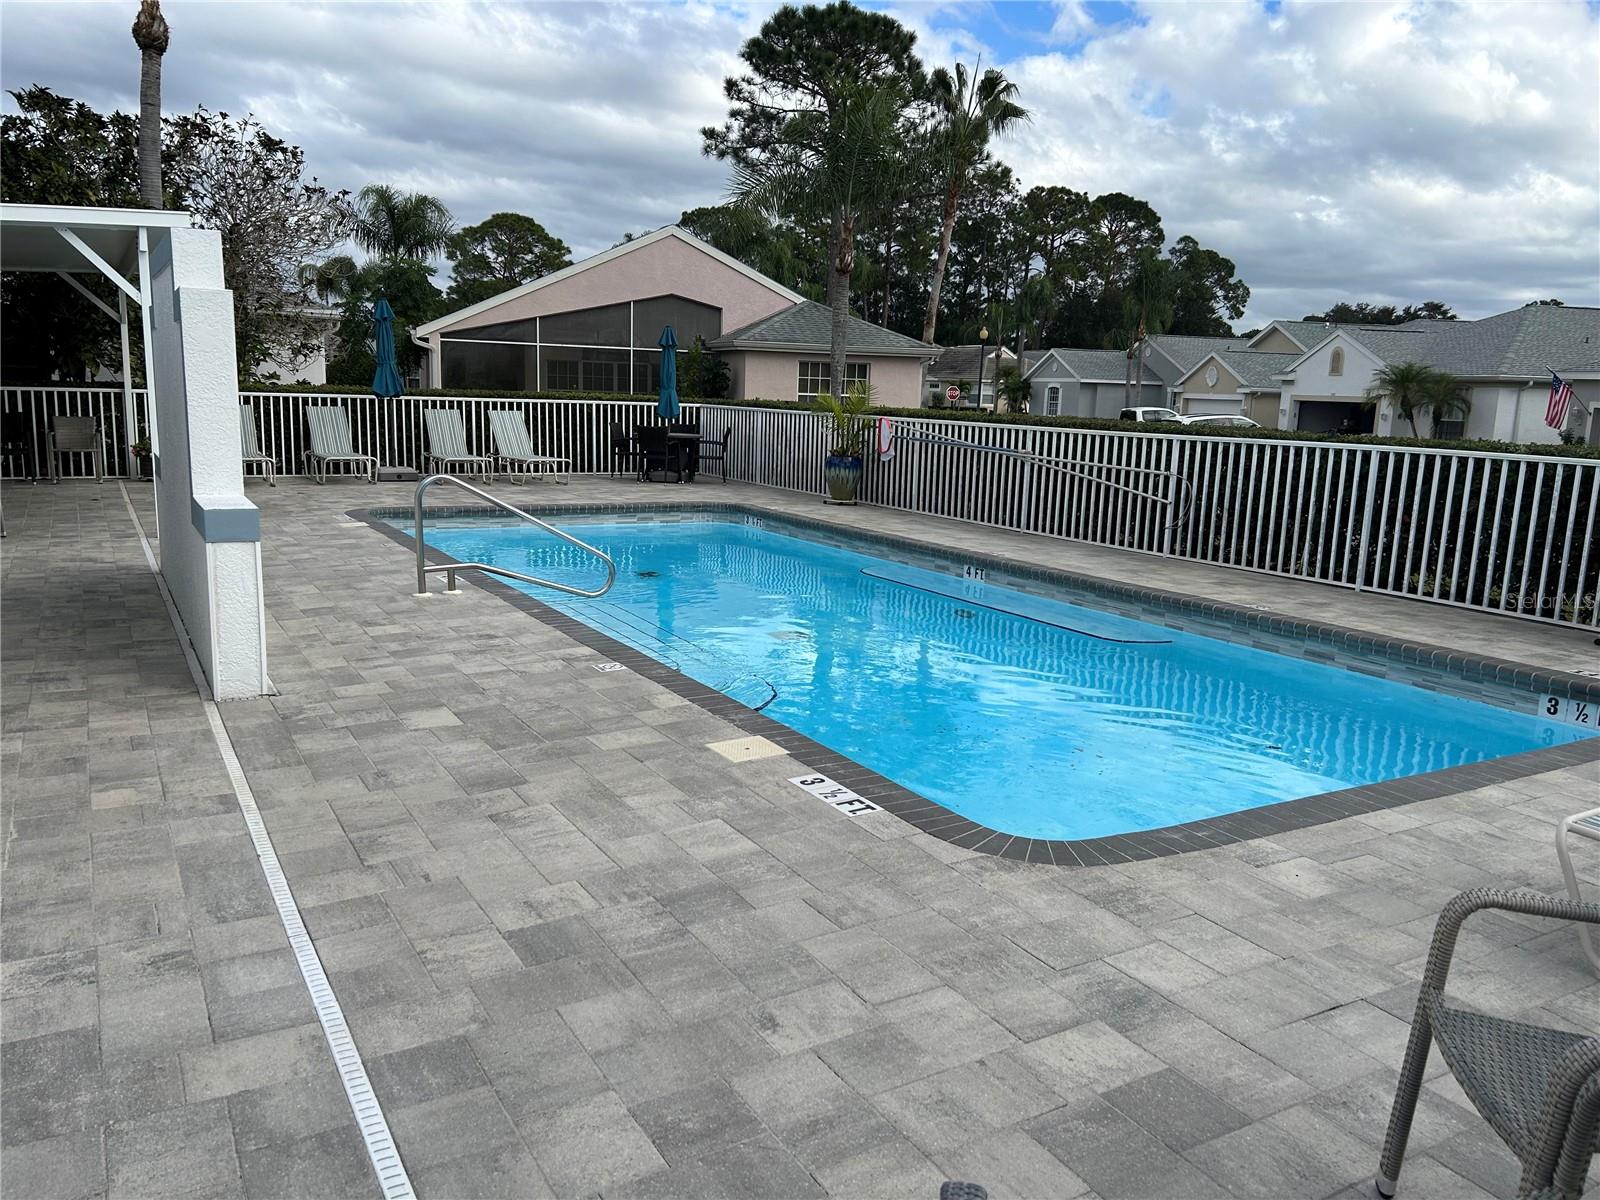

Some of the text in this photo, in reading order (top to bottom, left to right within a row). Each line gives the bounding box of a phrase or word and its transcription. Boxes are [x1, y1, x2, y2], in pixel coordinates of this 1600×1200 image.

[966, 566, 984, 580] 4 FT
[1546, 696, 1560, 716] 3
[800, 777, 825, 786] 3
